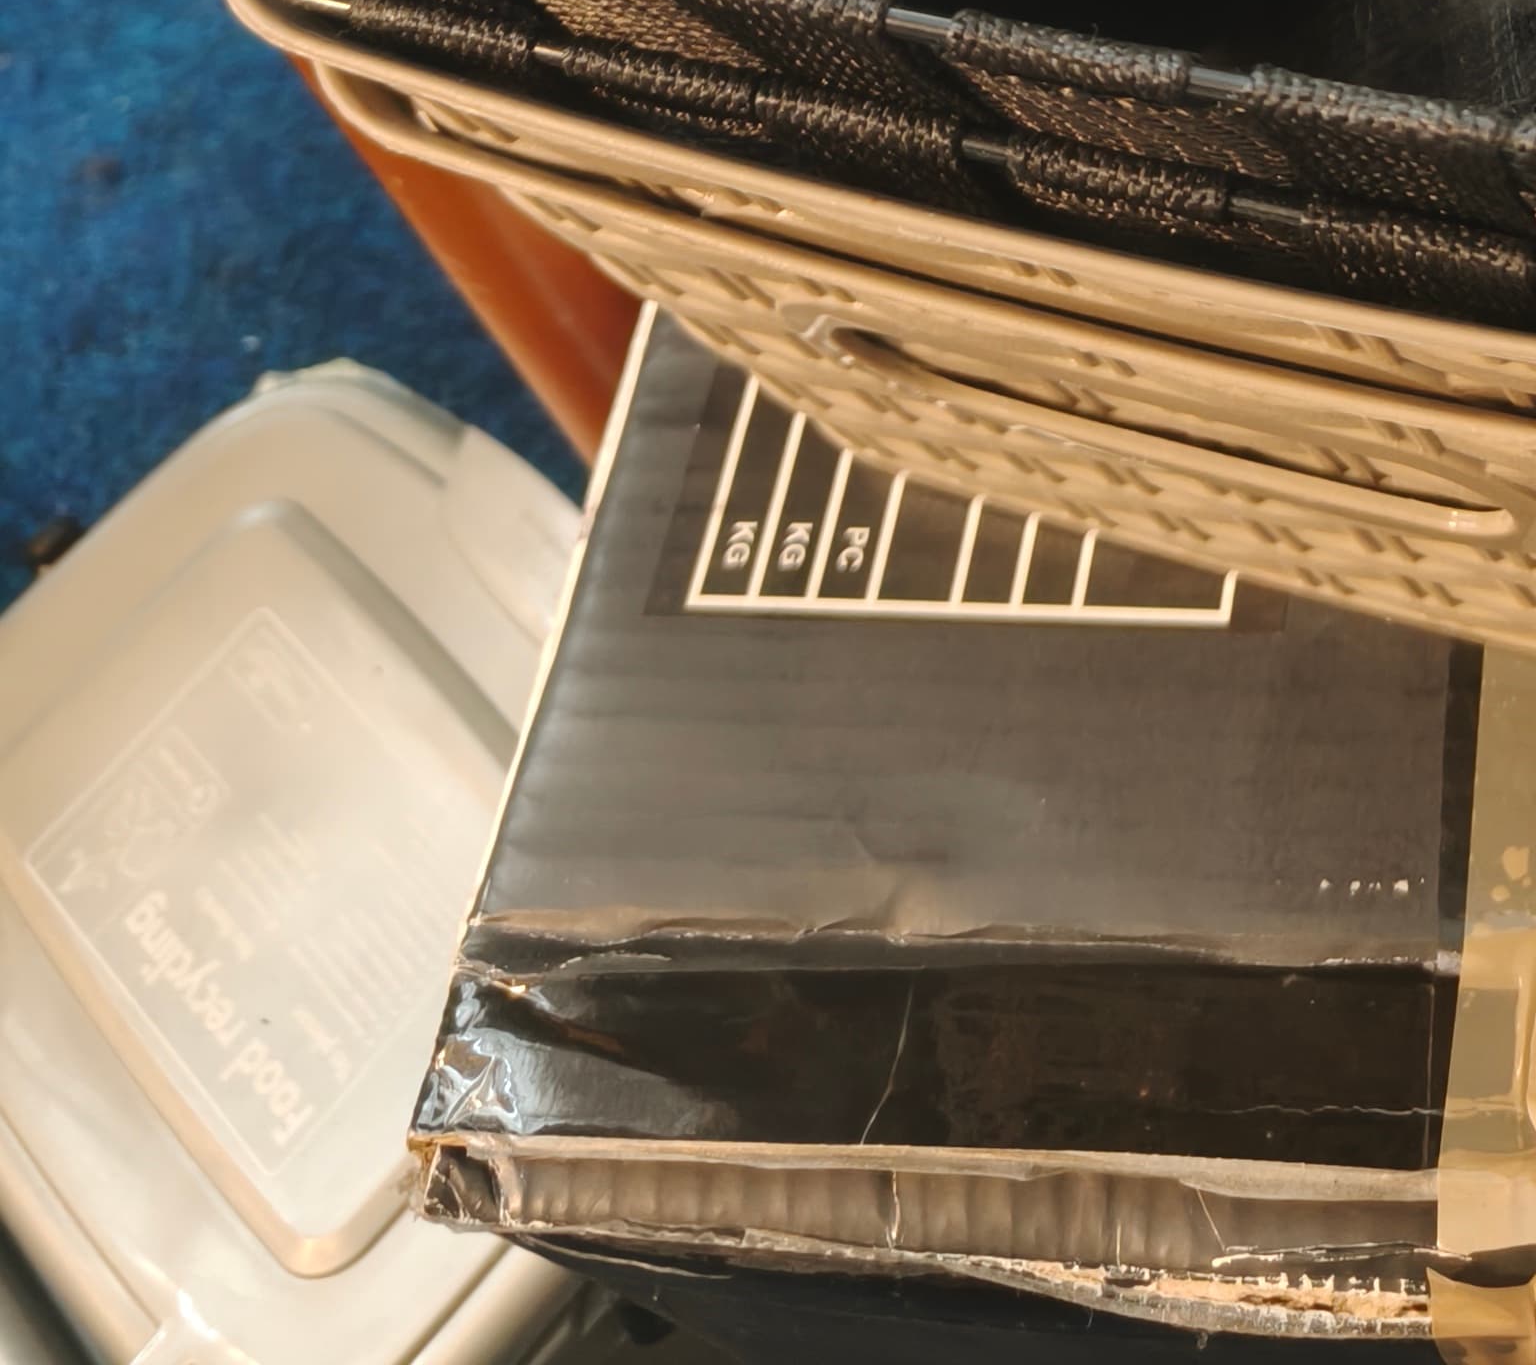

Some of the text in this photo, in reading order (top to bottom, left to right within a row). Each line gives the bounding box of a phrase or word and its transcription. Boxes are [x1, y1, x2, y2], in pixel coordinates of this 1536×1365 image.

[721, 521, 758, 571] KG
[777, 522, 813, 572] KG
[836, 526, 870, 573] PC
[120, 890, 247, 1050] recycling
[217, 1035, 316, 1147] Food
